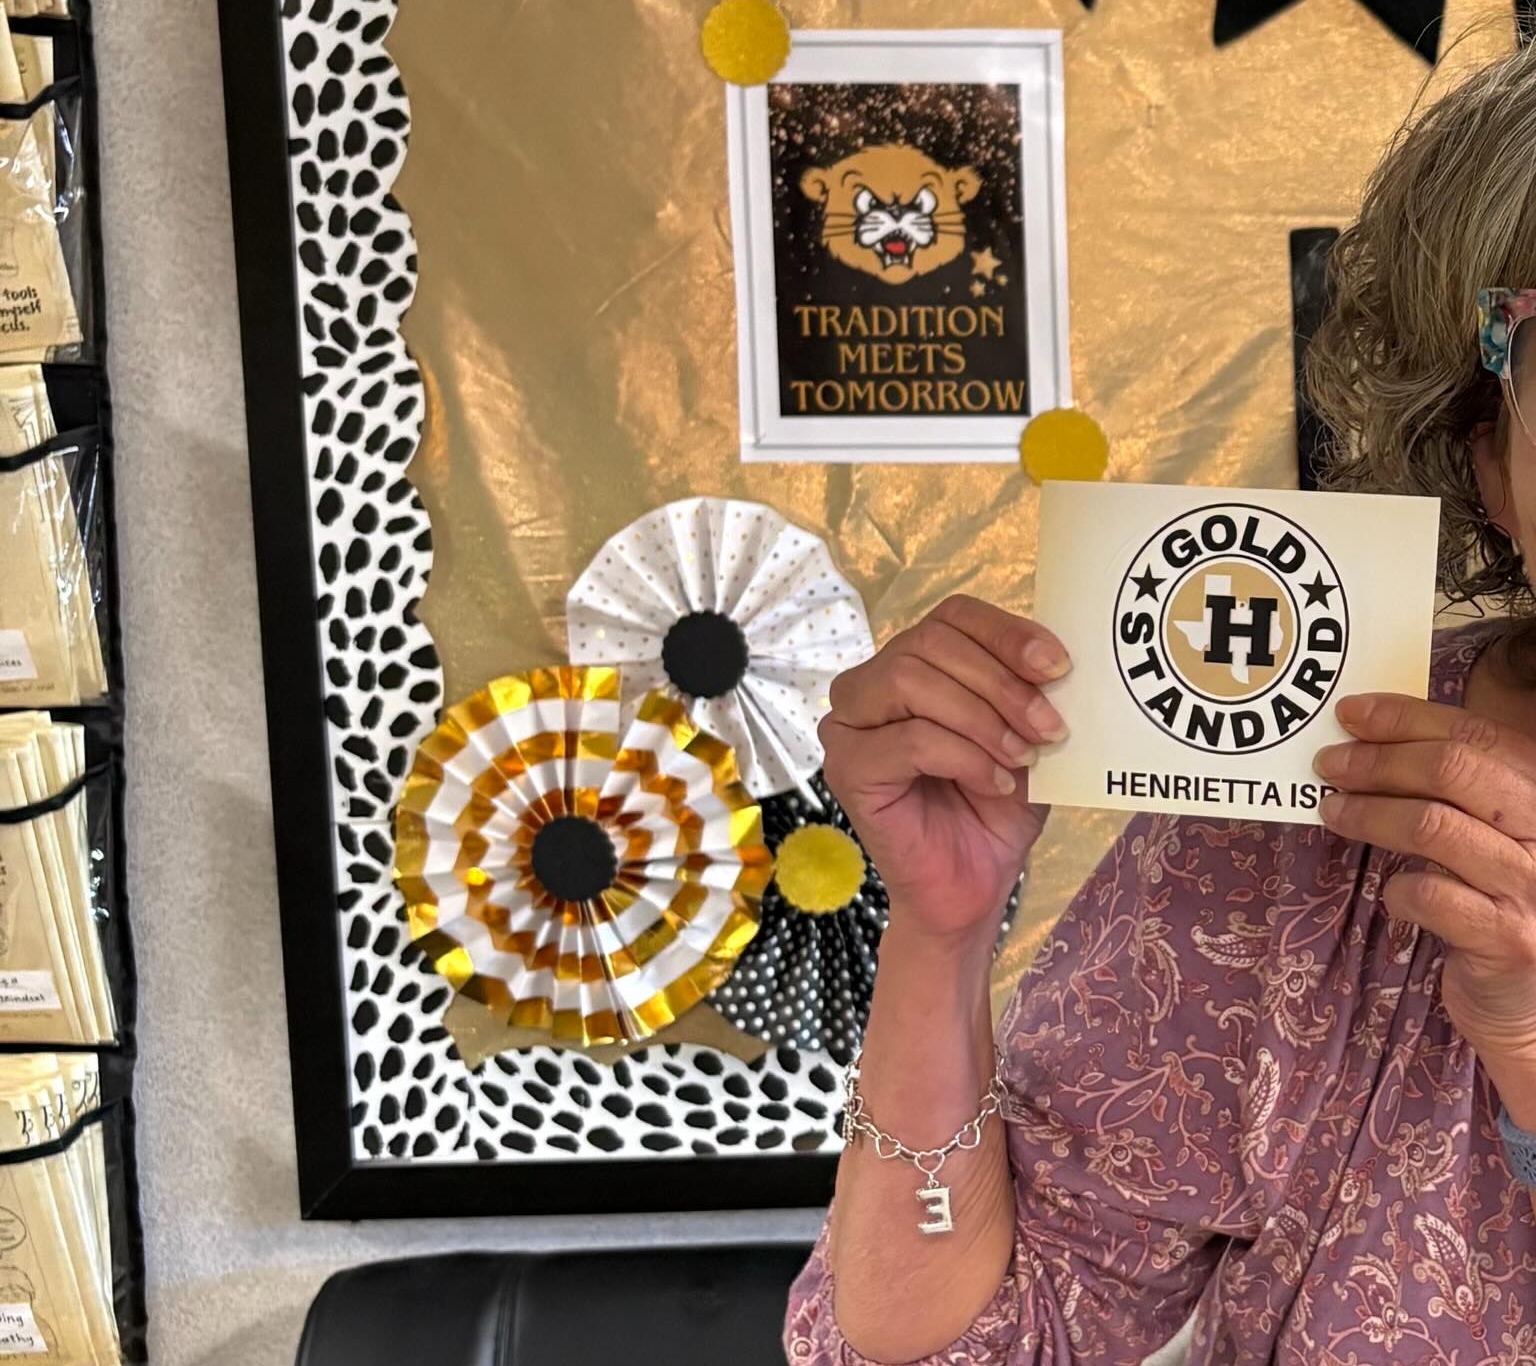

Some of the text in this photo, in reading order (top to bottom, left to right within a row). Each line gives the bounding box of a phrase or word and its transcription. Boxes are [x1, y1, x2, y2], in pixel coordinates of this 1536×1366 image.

[3, 285, 38, 301] tools
[794, 306, 1004, 336] TRADITION
[838, 344, 967, 374] MEETS
[790, 381, 1026, 411] TOMORROW
[1161, 514, 1307, 574] GOLD
[1203, 594, 1278, 667] H
[1120, 611, 1343, 749] STANDARD
[1107, 770, 1282, 807] HENRIETTA
